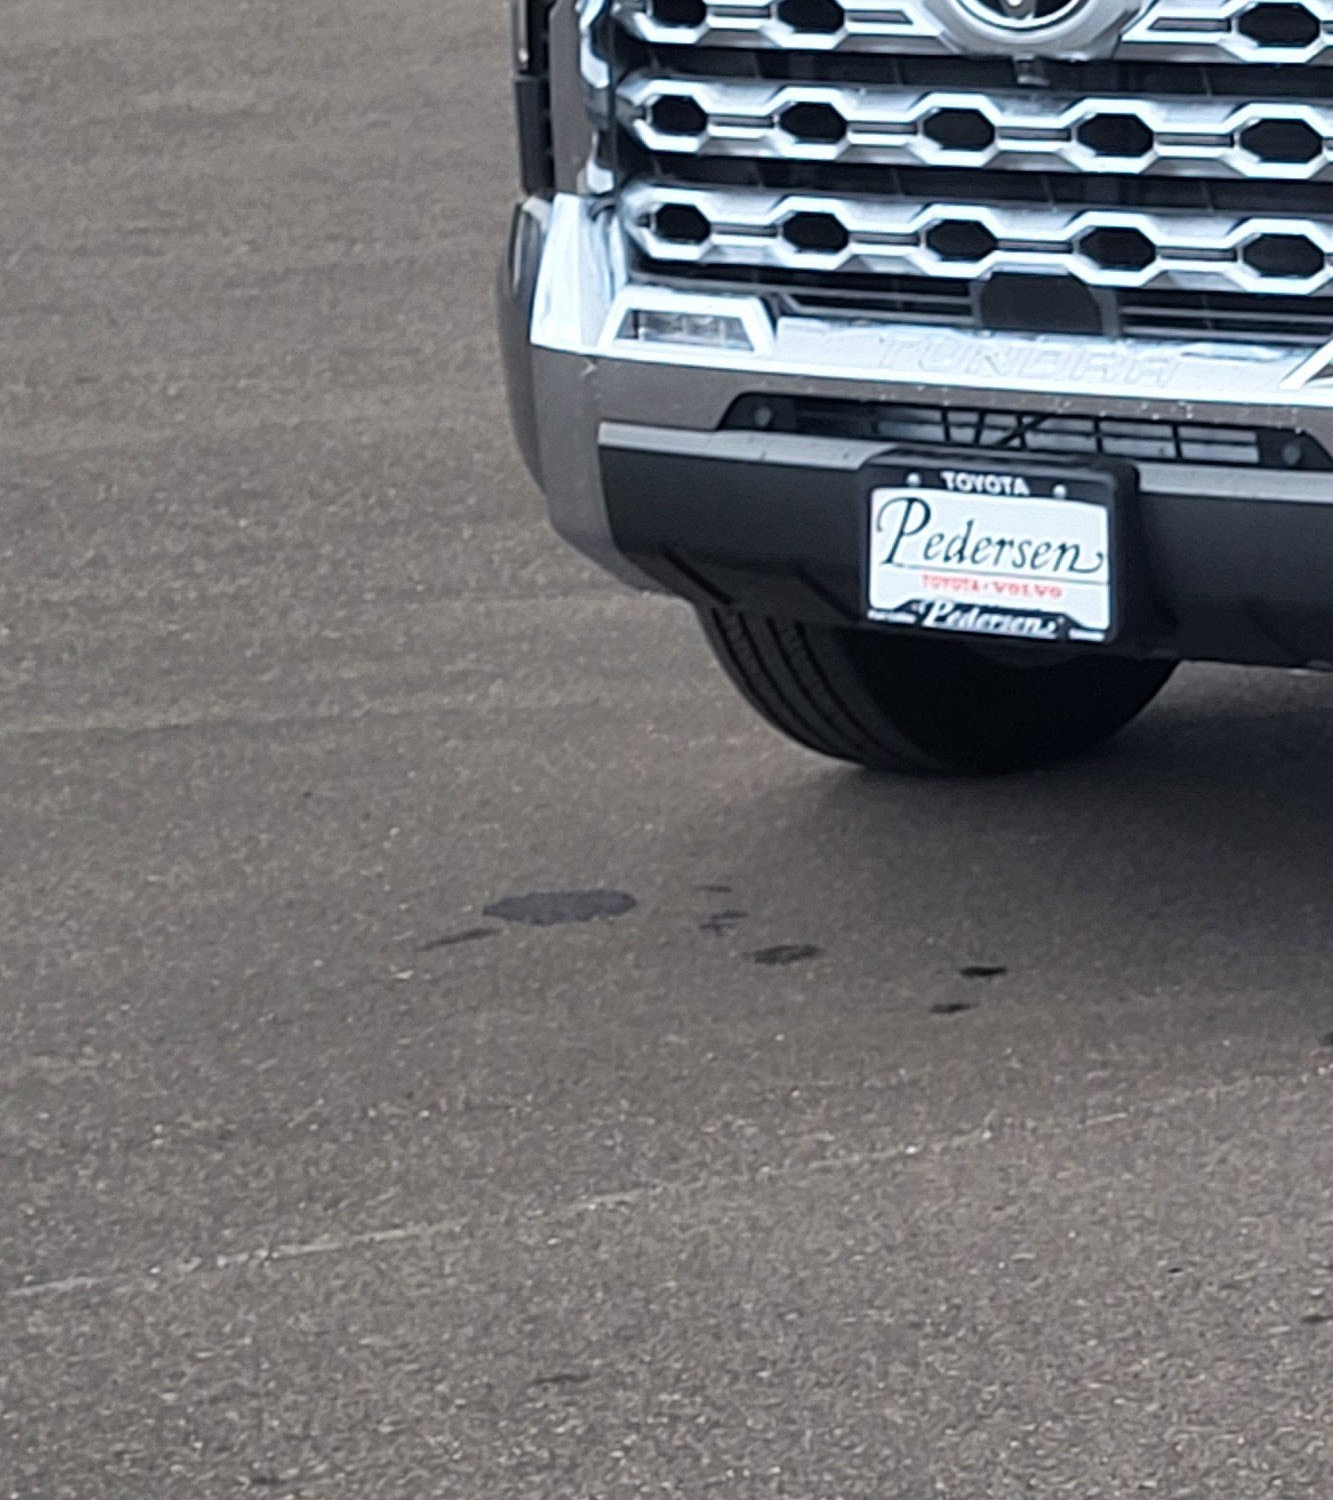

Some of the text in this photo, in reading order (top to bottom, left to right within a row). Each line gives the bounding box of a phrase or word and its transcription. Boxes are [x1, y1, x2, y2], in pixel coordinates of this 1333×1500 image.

[879, 336, 1184, 389] TUNDRA
[940, 471, 1030, 497] TOYOTA
[876, 496, 1103, 574] Pedersen
[921, 599, 1058, 637] Pedersen
